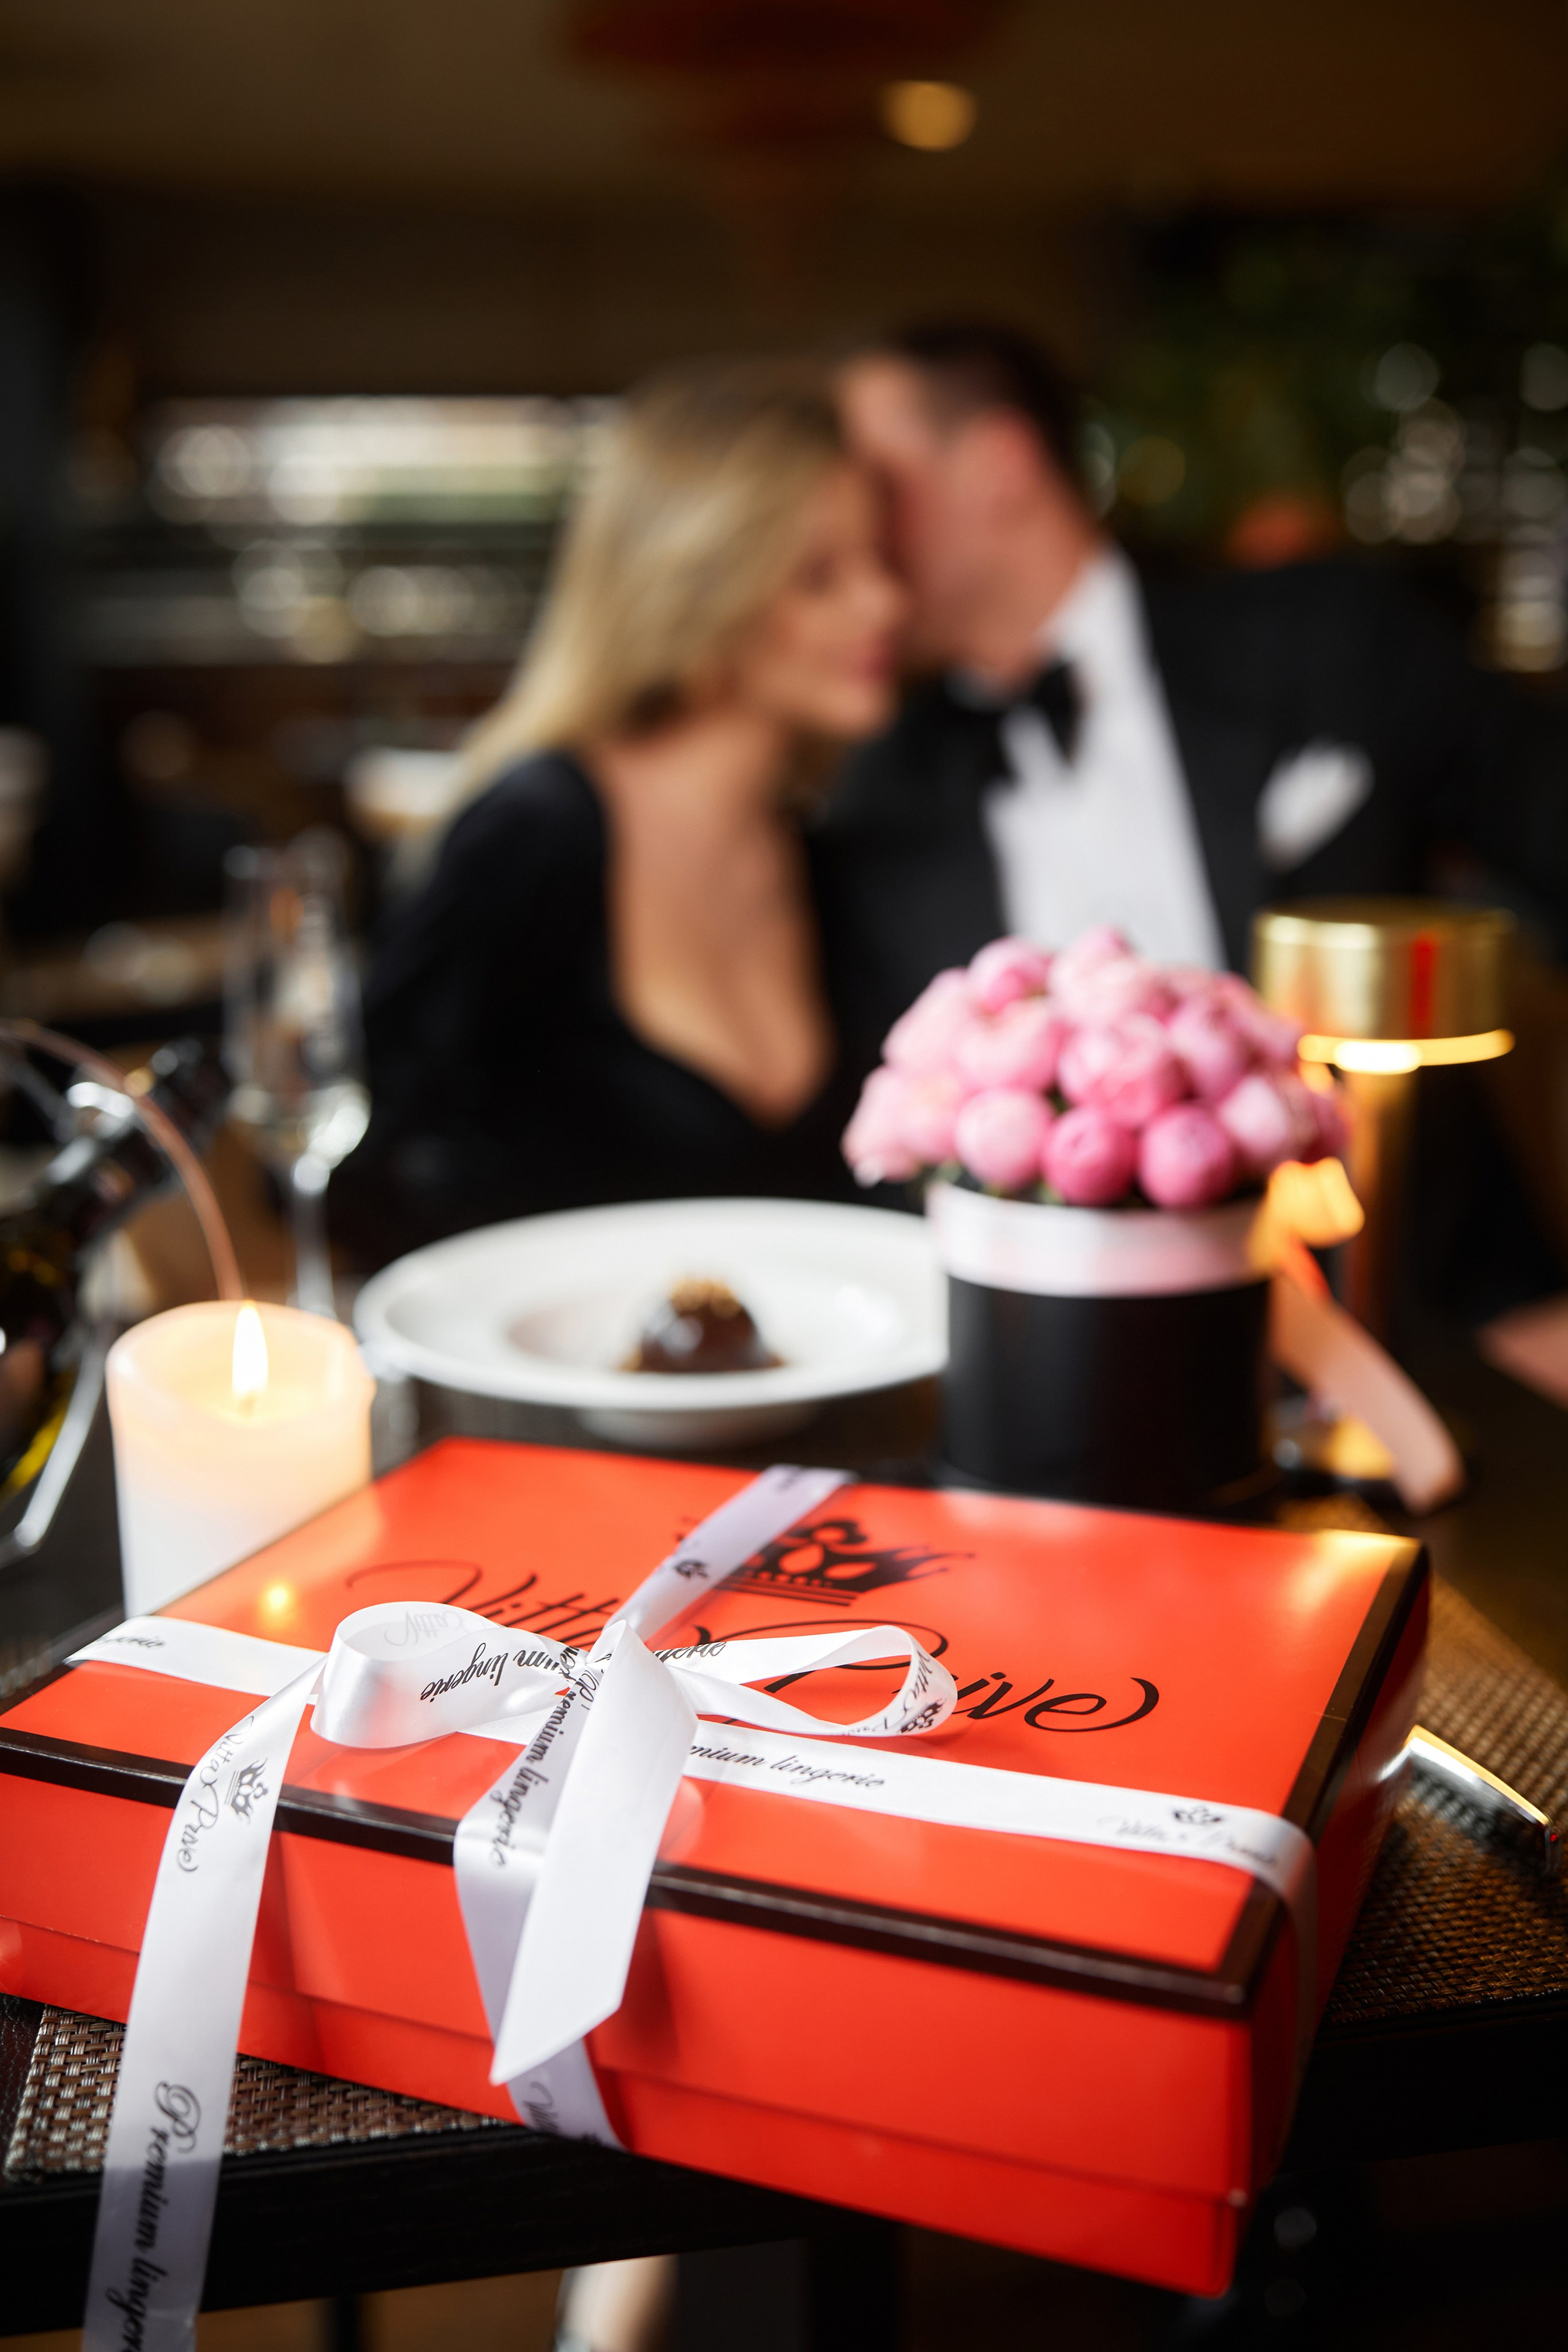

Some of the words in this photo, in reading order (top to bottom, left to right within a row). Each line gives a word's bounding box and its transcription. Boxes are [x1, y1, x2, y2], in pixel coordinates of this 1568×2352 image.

[420, 1642, 508, 1703] lingerie
[490, 1766, 550, 1865] lingerie
[769, 1754, 886, 1787] lingerie
[132, 2081, 202, 2253] Premium
[105, 2256, 168, 2352] linger
